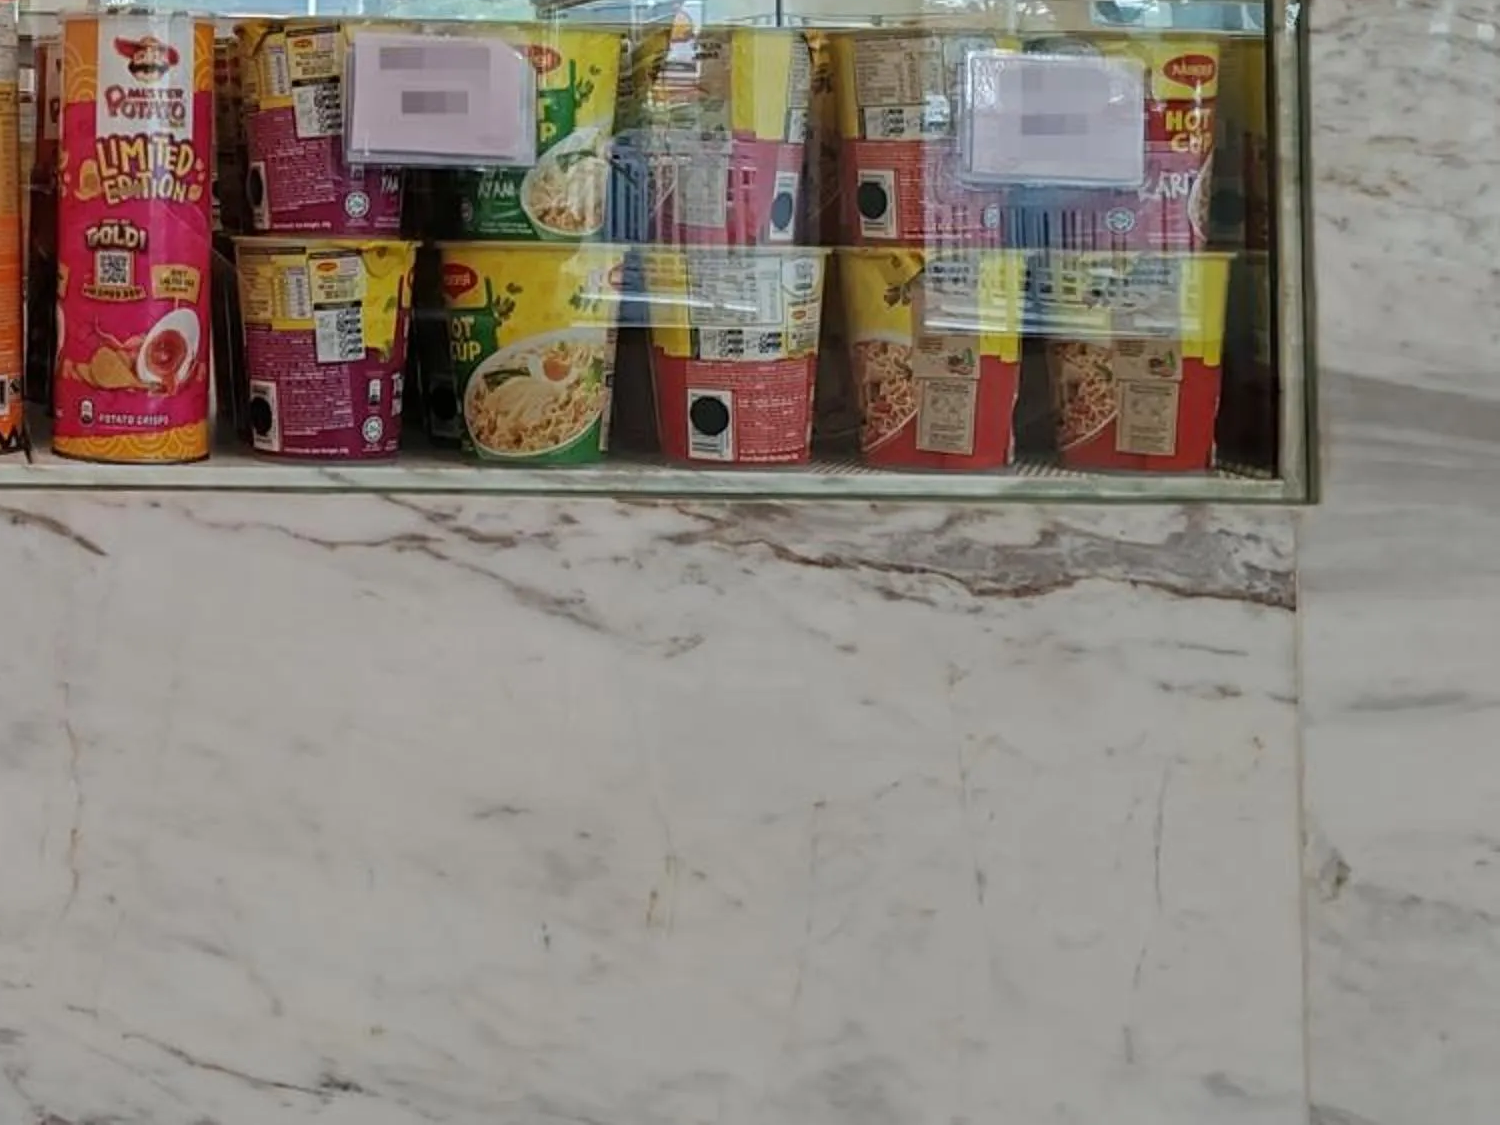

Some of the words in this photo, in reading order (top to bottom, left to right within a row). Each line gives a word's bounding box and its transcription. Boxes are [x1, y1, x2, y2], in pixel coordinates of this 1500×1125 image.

[1165, 109, 1211, 132] HOT
[95, 134, 194, 179] LIMITED
[103, 170, 188, 205] EDITION
